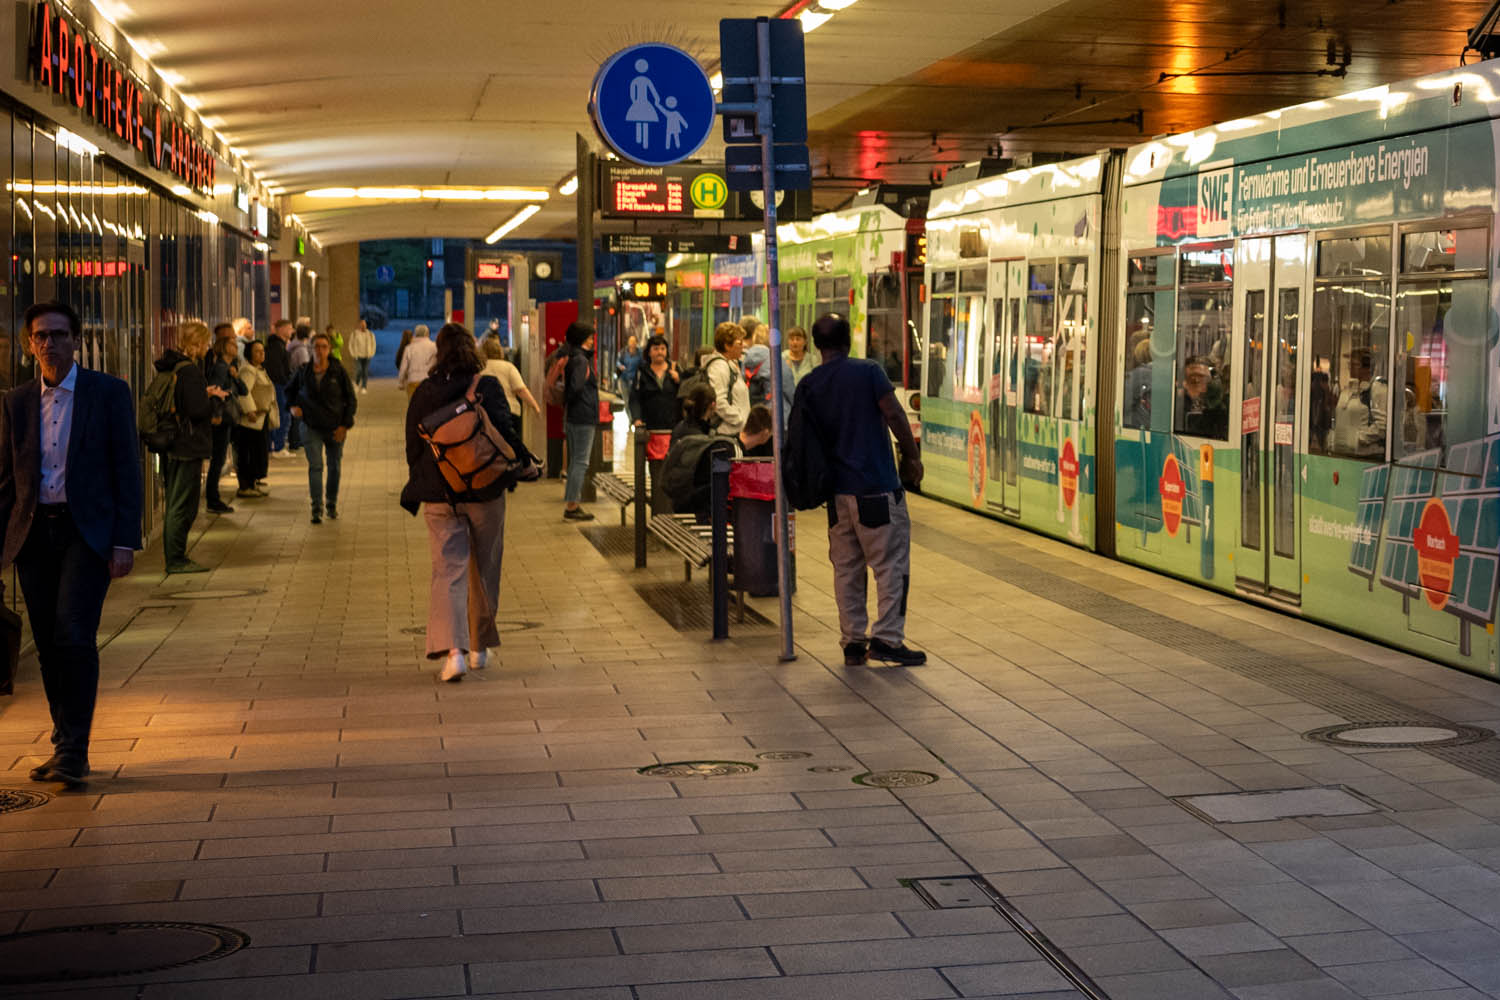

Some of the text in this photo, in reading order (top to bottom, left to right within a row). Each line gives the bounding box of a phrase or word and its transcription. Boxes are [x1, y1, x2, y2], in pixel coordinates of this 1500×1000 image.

[40, 2, 144, 153] APOTHEKE
[609, 167, 664, 177] Hauptbahnhof
[1200, 167, 1230, 226] SWE
[1238, 140, 1429, 201] Fernwärme und Erneuerbare Energien
